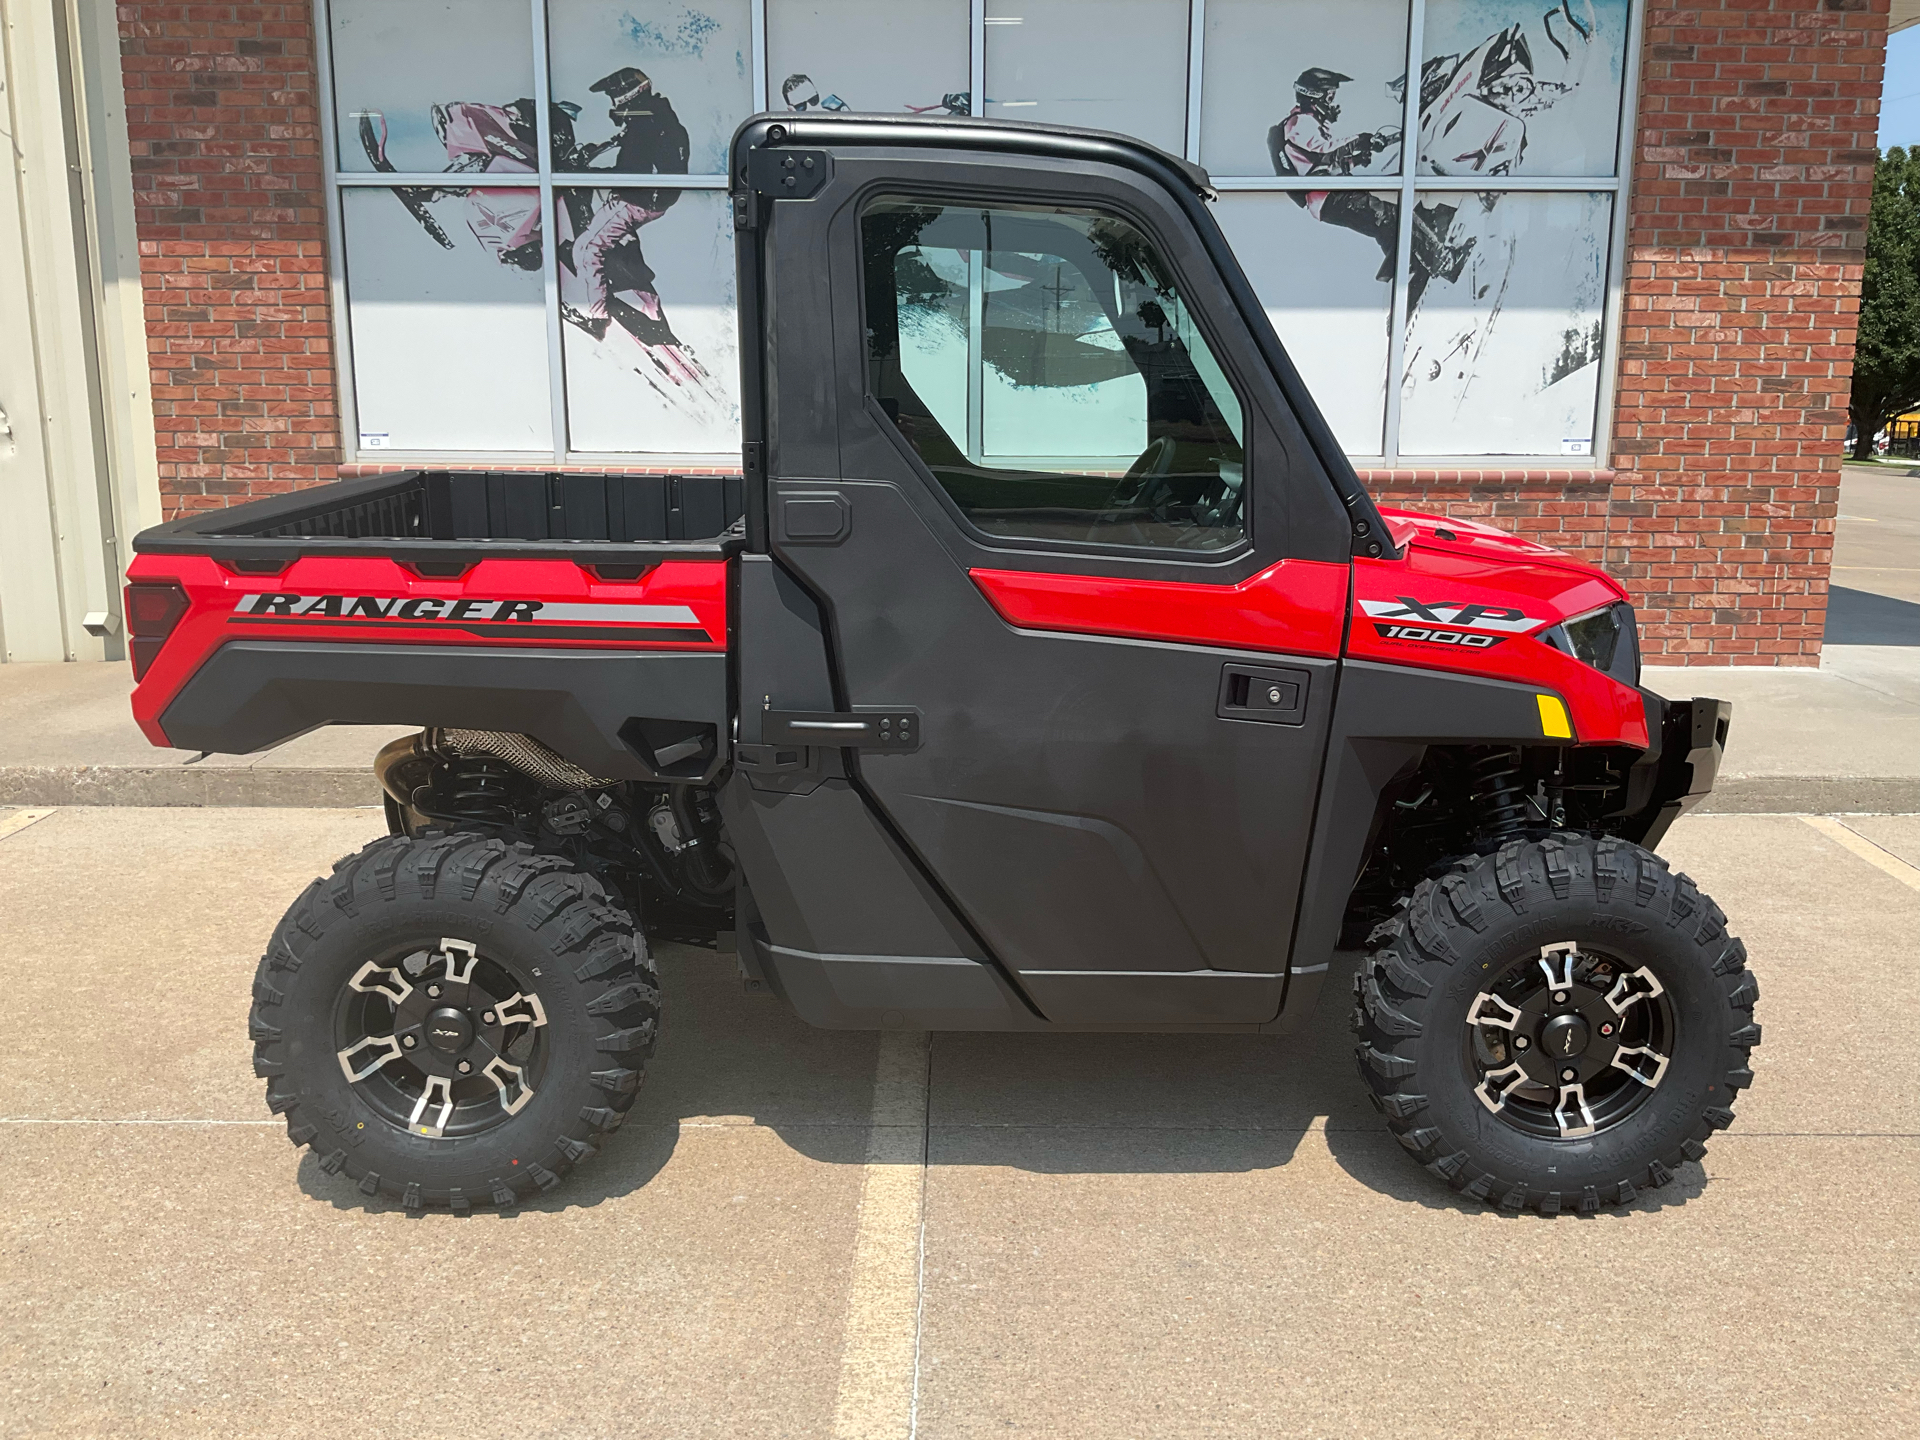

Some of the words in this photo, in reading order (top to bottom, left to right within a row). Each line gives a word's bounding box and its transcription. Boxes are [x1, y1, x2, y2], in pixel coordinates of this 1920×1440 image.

[248, 592, 544, 623] RANGER
[1372, 595, 1527, 626] XP
[1379, 640, 1406, 648] DUAL
[1407, 643, 1459, 653] OVERHEAD
[1386, 625, 1493, 648] 1000
[1446, 914, 1558, 1003] X-TERRAIN
